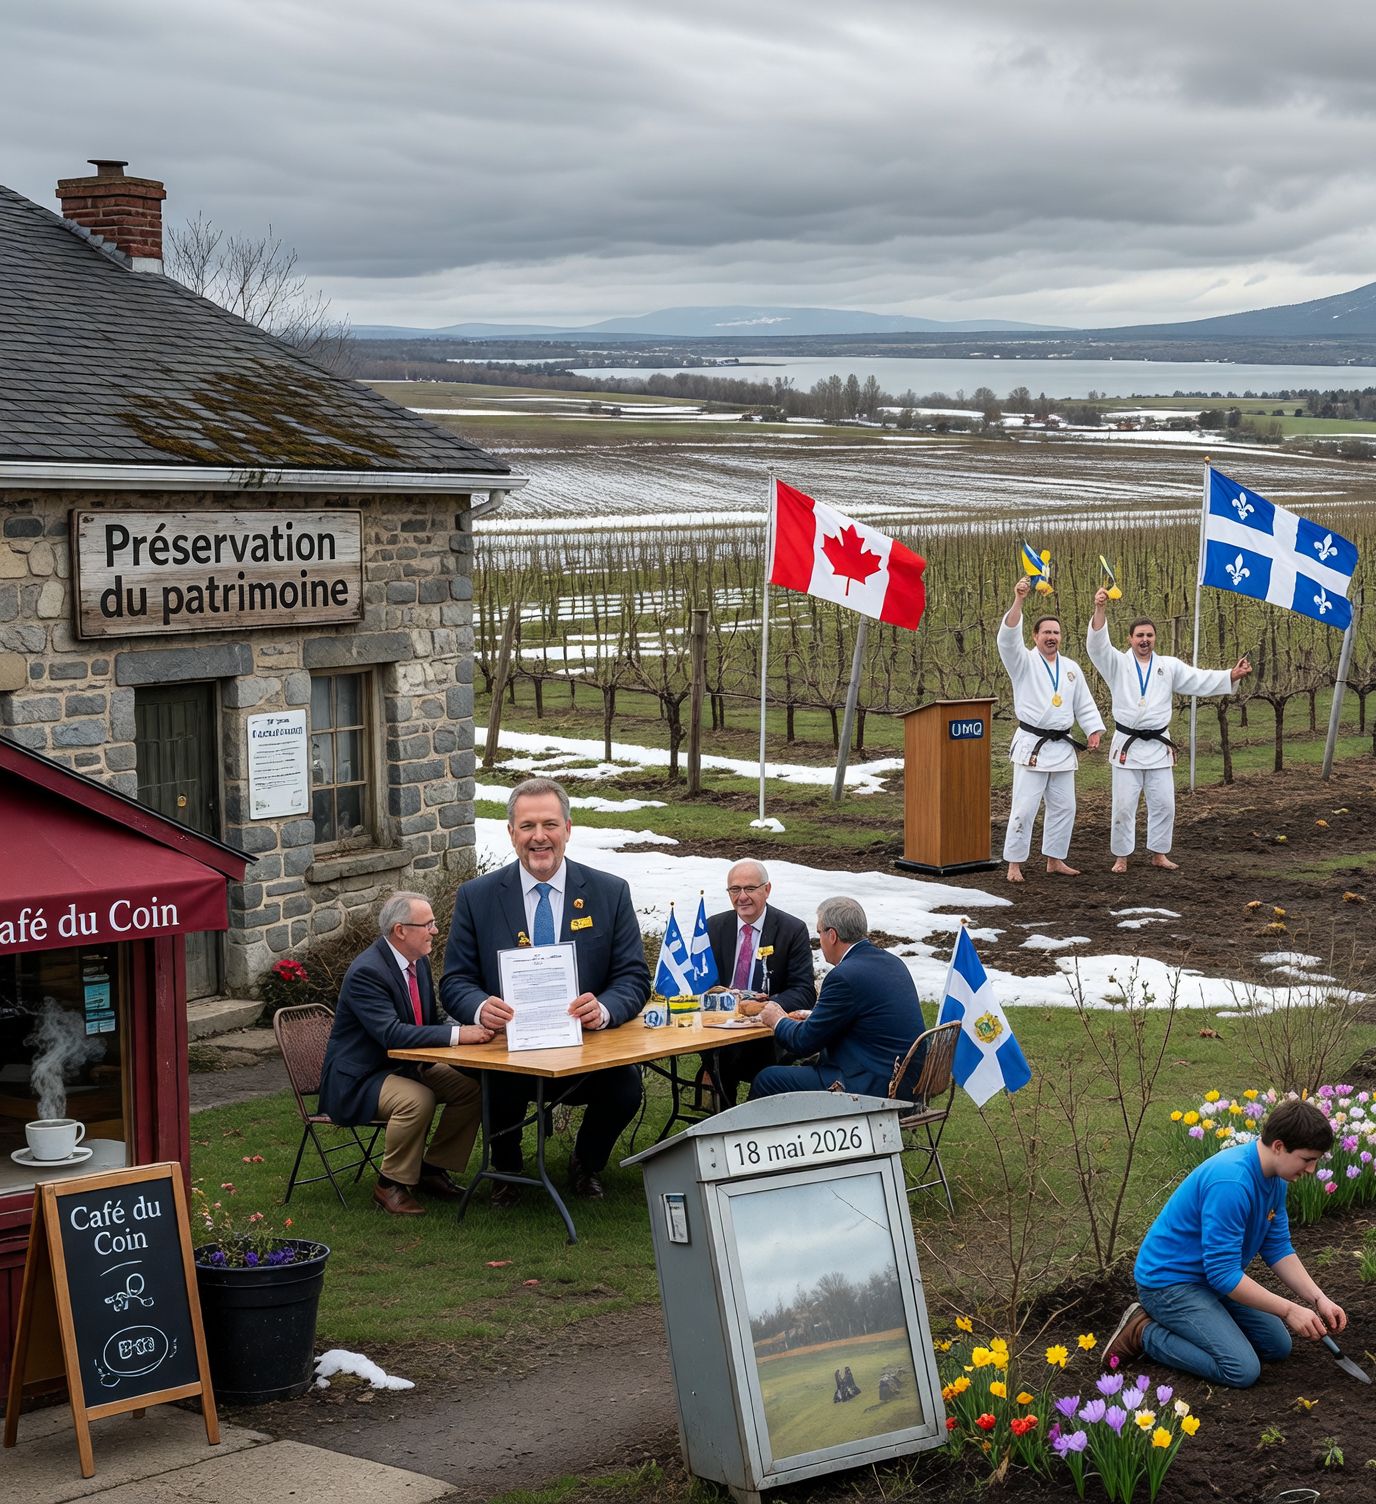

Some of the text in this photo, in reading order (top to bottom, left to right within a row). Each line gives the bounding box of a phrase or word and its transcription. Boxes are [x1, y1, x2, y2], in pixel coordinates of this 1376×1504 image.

[105, 521, 336, 568] Préservation
[100, 569, 349, 626] du patrimoine
[952, 722, 982, 736] UMQ
[0, 896, 180, 945] afé du Coin
[734, 1126, 863, 1166] 18 mai 2026
[70, 1196, 161, 1230] Café du
[94, 1228, 148, 1255] Coin
